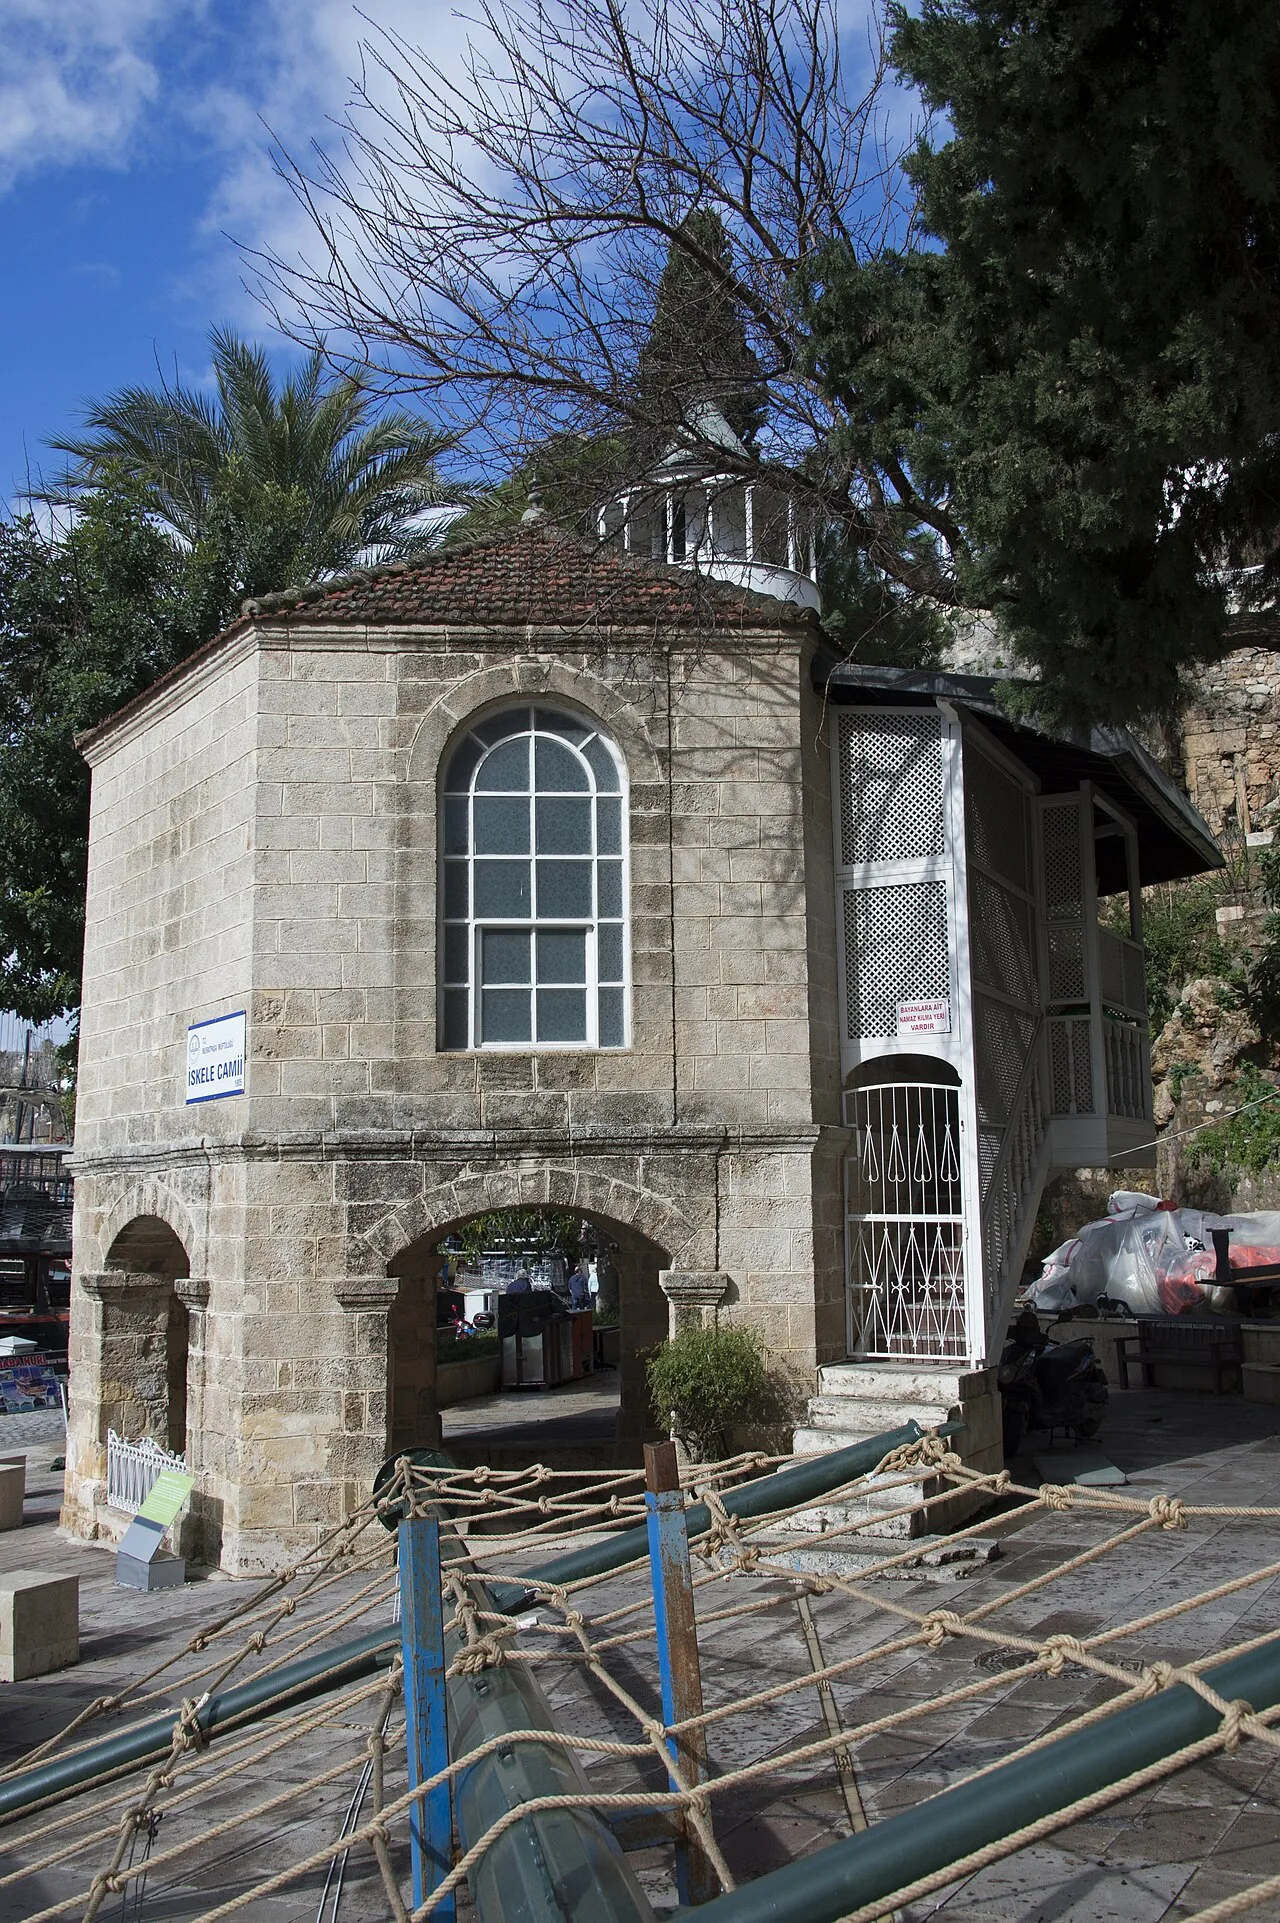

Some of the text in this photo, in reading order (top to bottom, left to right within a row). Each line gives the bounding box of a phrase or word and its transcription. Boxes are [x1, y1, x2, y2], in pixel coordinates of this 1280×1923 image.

[900, 1005, 932, 1013] BAYANLARA
[900, 1015, 916, 1023] NAMAZ
[911, 1023, 934, 1031] VARDIR
[188, 1054, 243, 1086] İSKELE CAMİİ
